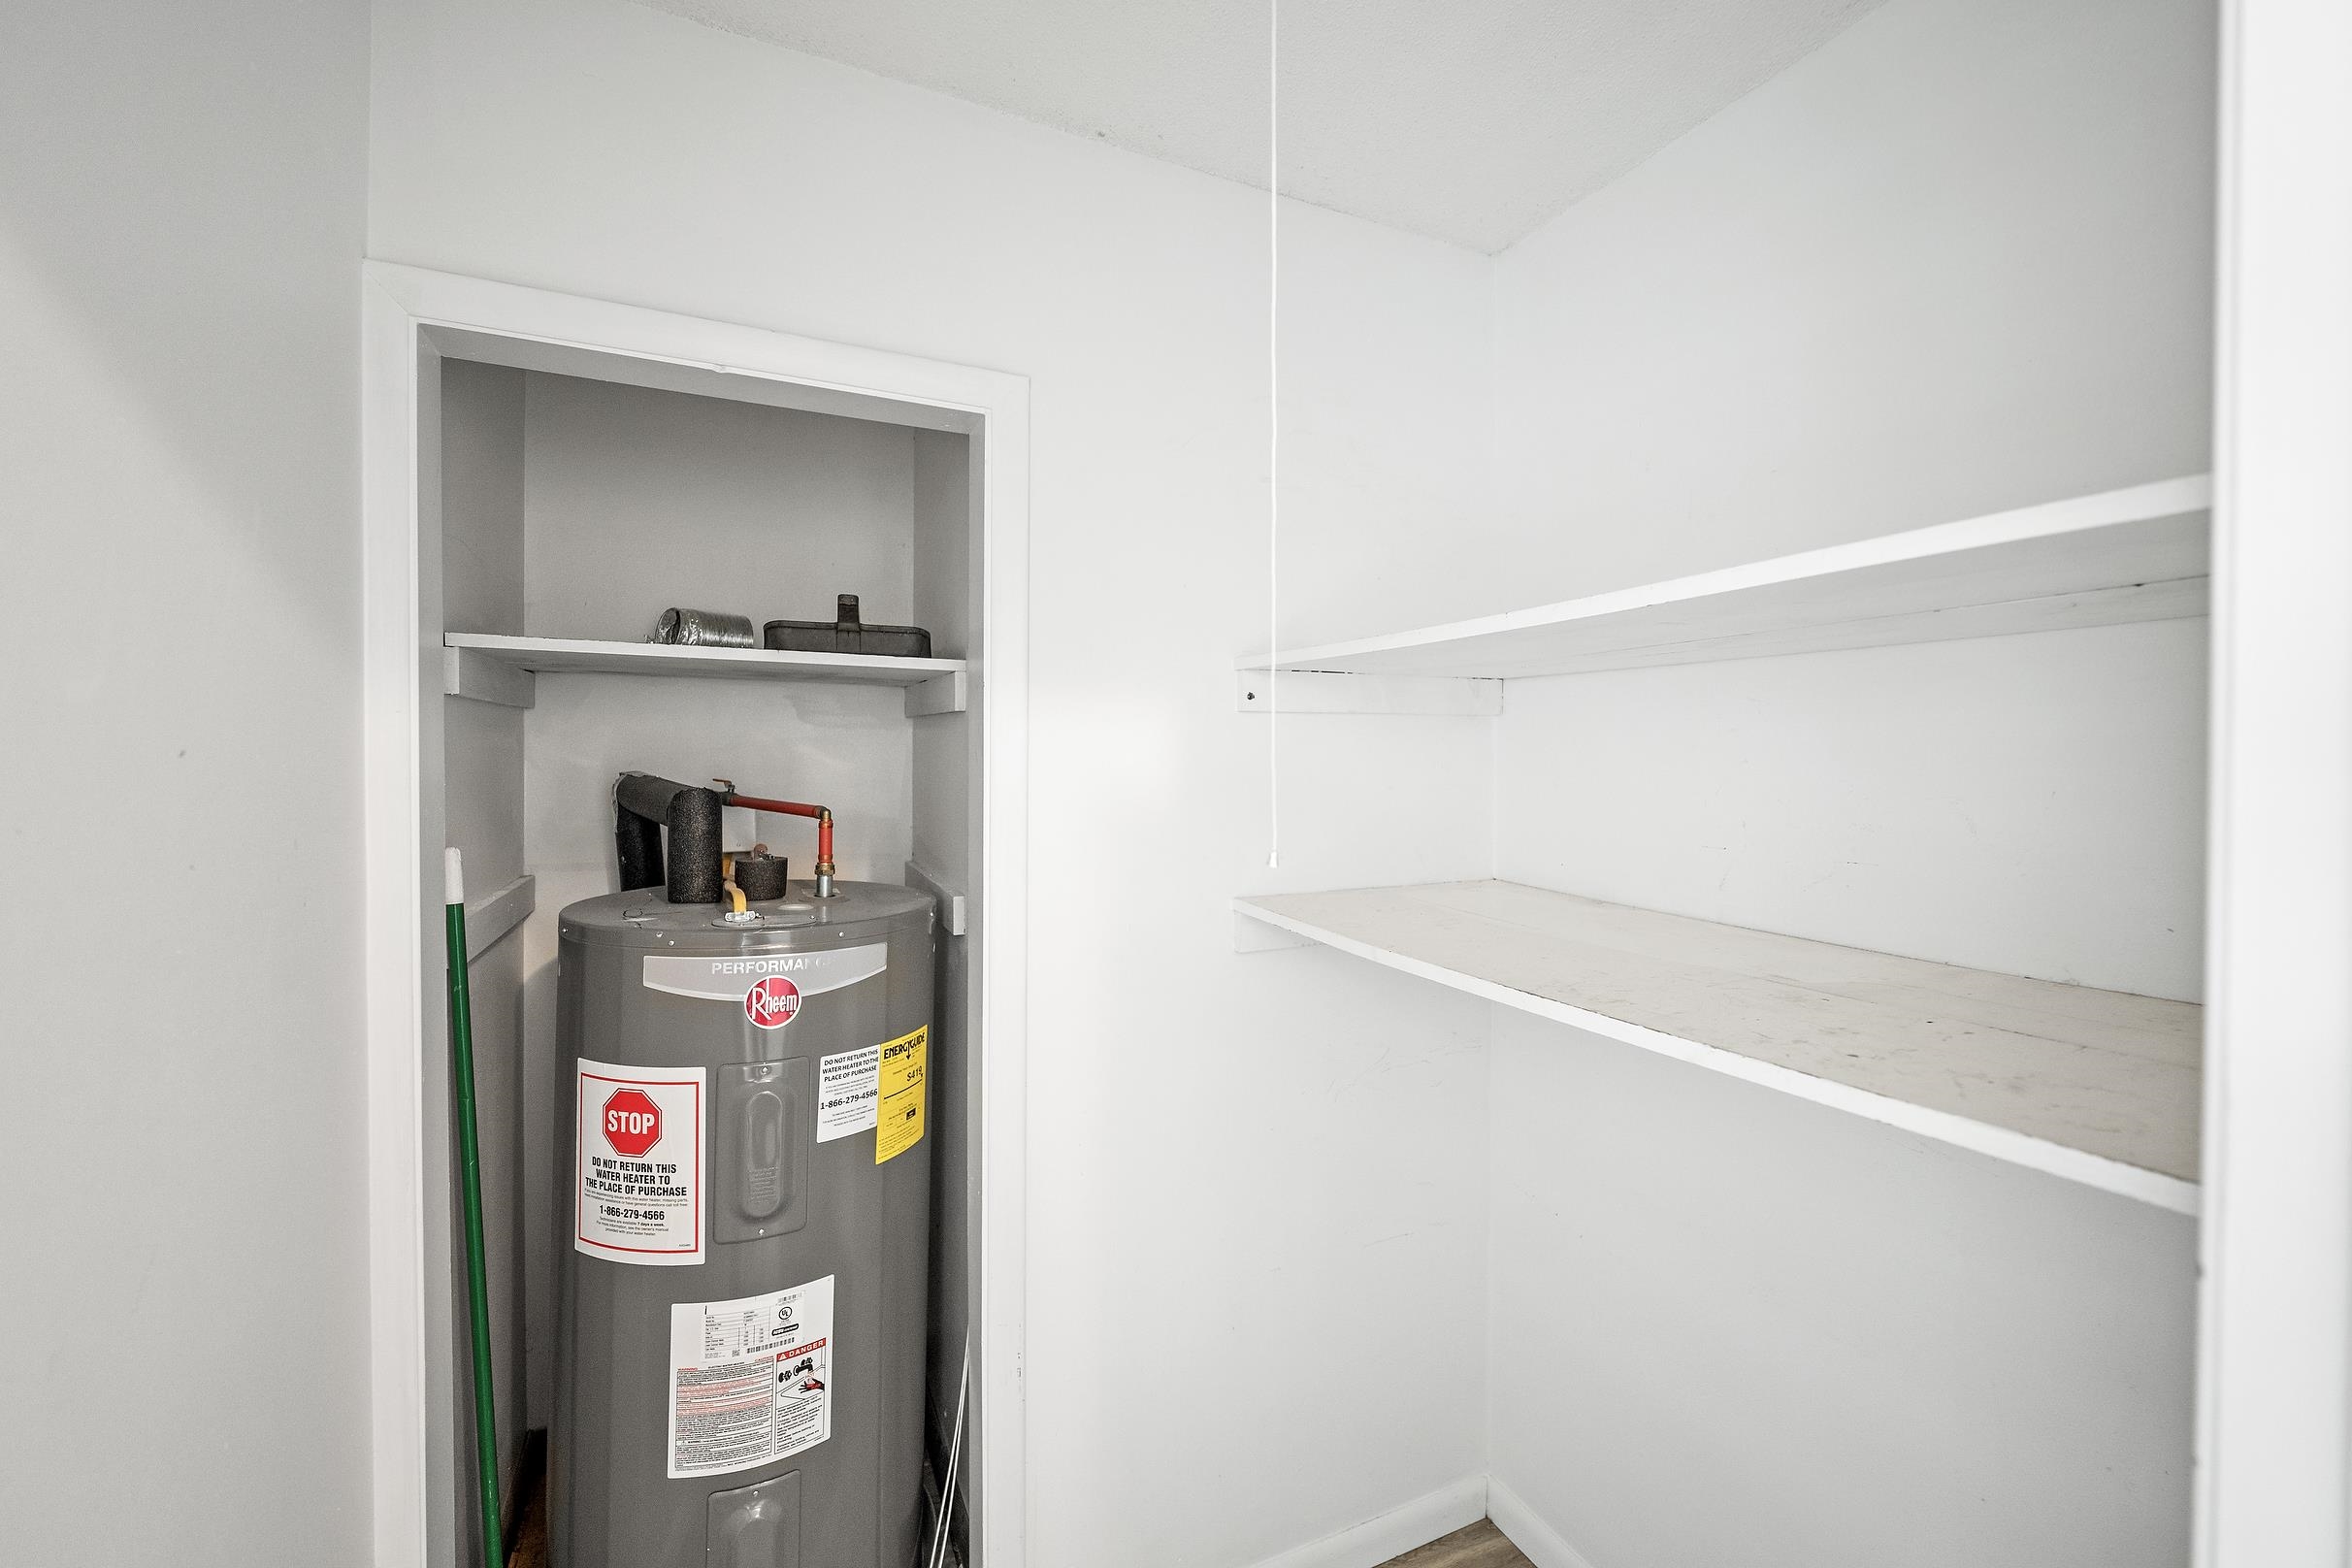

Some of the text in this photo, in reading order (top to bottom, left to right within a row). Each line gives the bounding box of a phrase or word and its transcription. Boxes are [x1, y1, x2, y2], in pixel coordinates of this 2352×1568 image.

[751, 977, 798, 1021] Rheem
[833, 1056, 846, 1064] NOT
[847, 1051, 867, 1062] RETURN
[867, 1048, 879, 1057] THIS
[822, 1065, 842, 1075] WATER
[842, 1061, 863, 1071] HEATER
[824, 1073, 842, 1083] PLACE
[851, 1064, 877, 1076] PURCHASE
[820, 1088, 878, 1110] 1-866-279-4566
[607, 1109, 655, 1135] STOP
[592, 1156, 677, 1174] DO NOT RETURN THIS
[585, 1176, 598, 1189] THE
[599, 1180, 623, 1193] PLACE
[624, 1184, 636, 1195] OF
[637, 1186, 687, 1196] PURCHASE
[596, 1168, 670, 1186] WATER HEATER TO
[599, 1204, 665, 1221] 1-866-279-4566
[789, 1340, 824, 1357] DANGER
